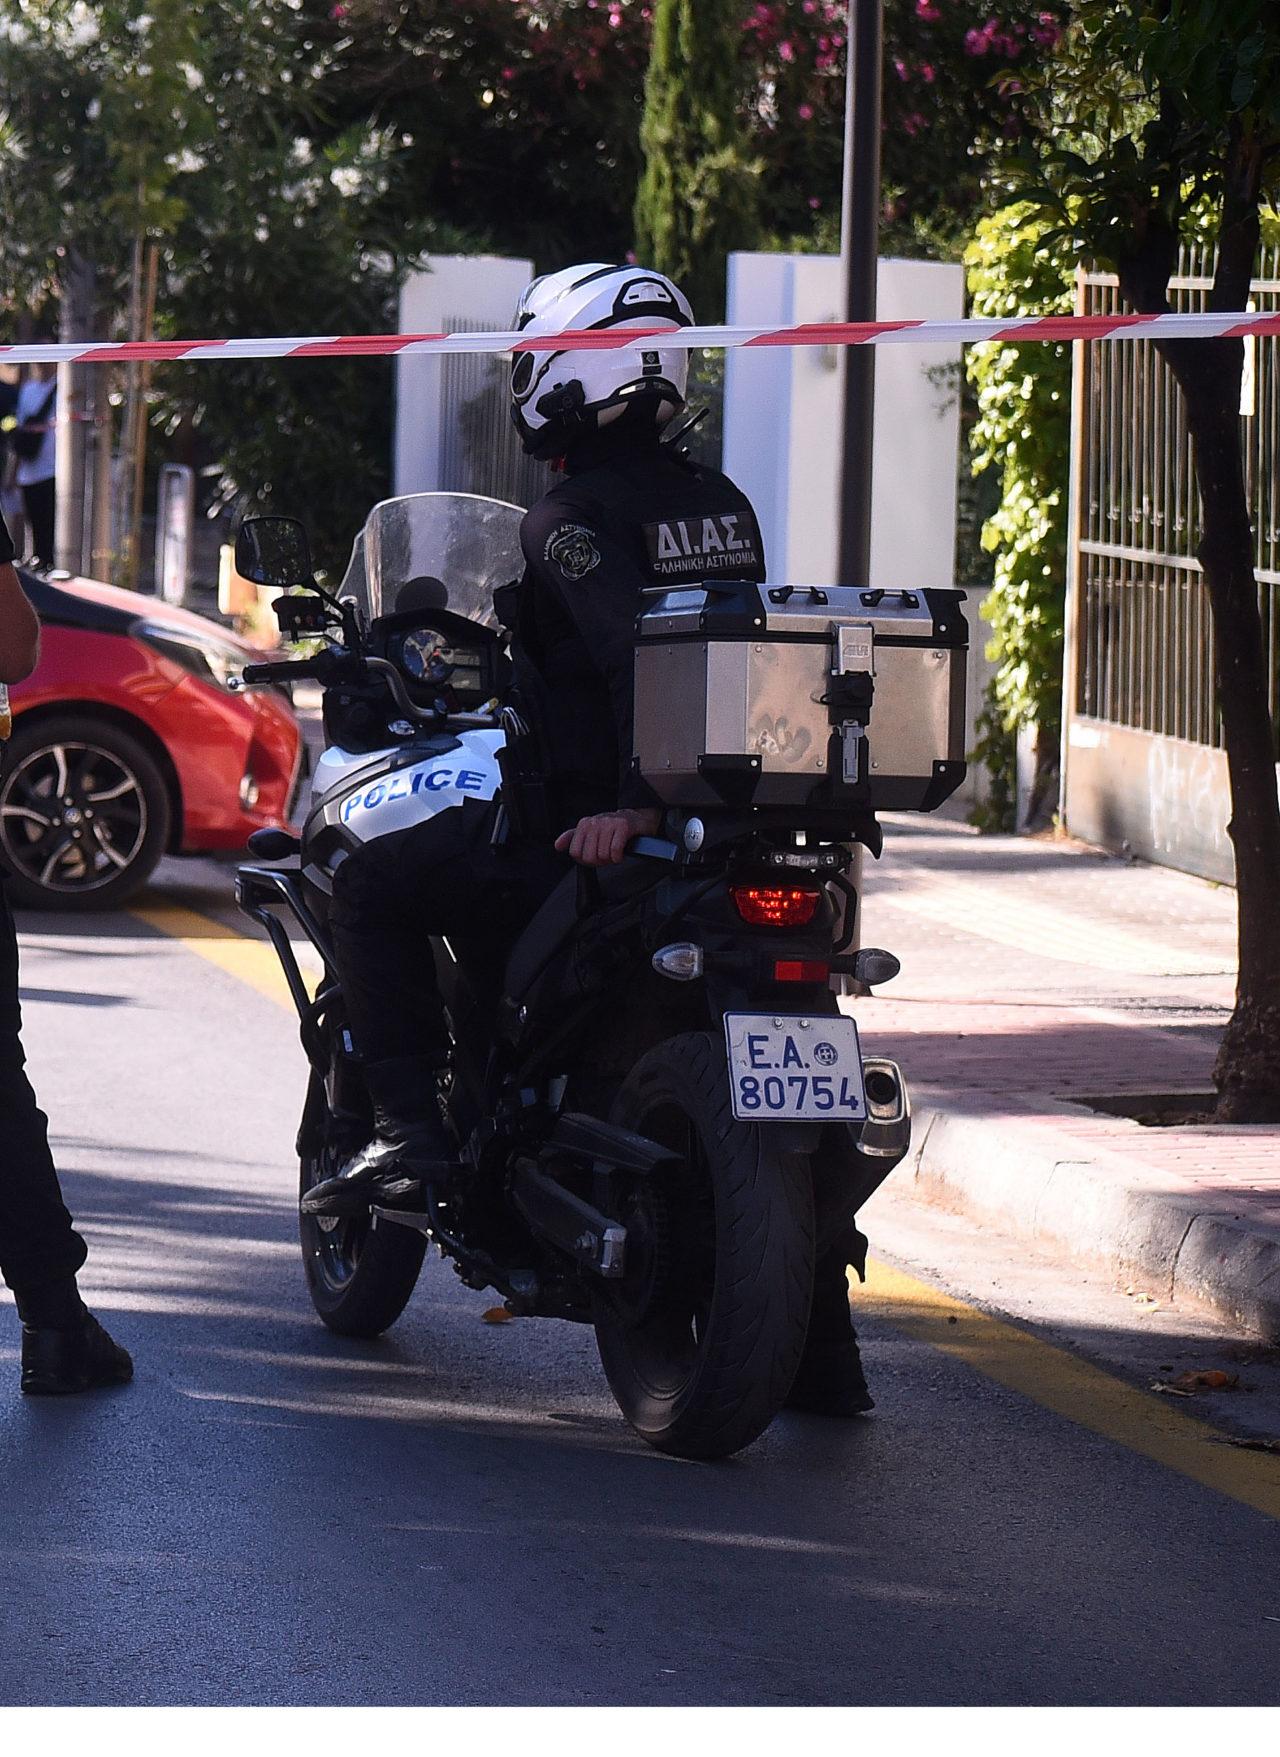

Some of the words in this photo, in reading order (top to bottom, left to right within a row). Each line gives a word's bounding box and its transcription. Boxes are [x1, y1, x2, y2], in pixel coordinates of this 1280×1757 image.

[657, 515, 751, 559] ΔΙ.ΑΣ.
[706, 552, 757, 572] ΑΣΤΥΝΟΜΙΑ
[344, 769, 487, 822] POLICE
[739, 1076, 859, 1110] 80754
